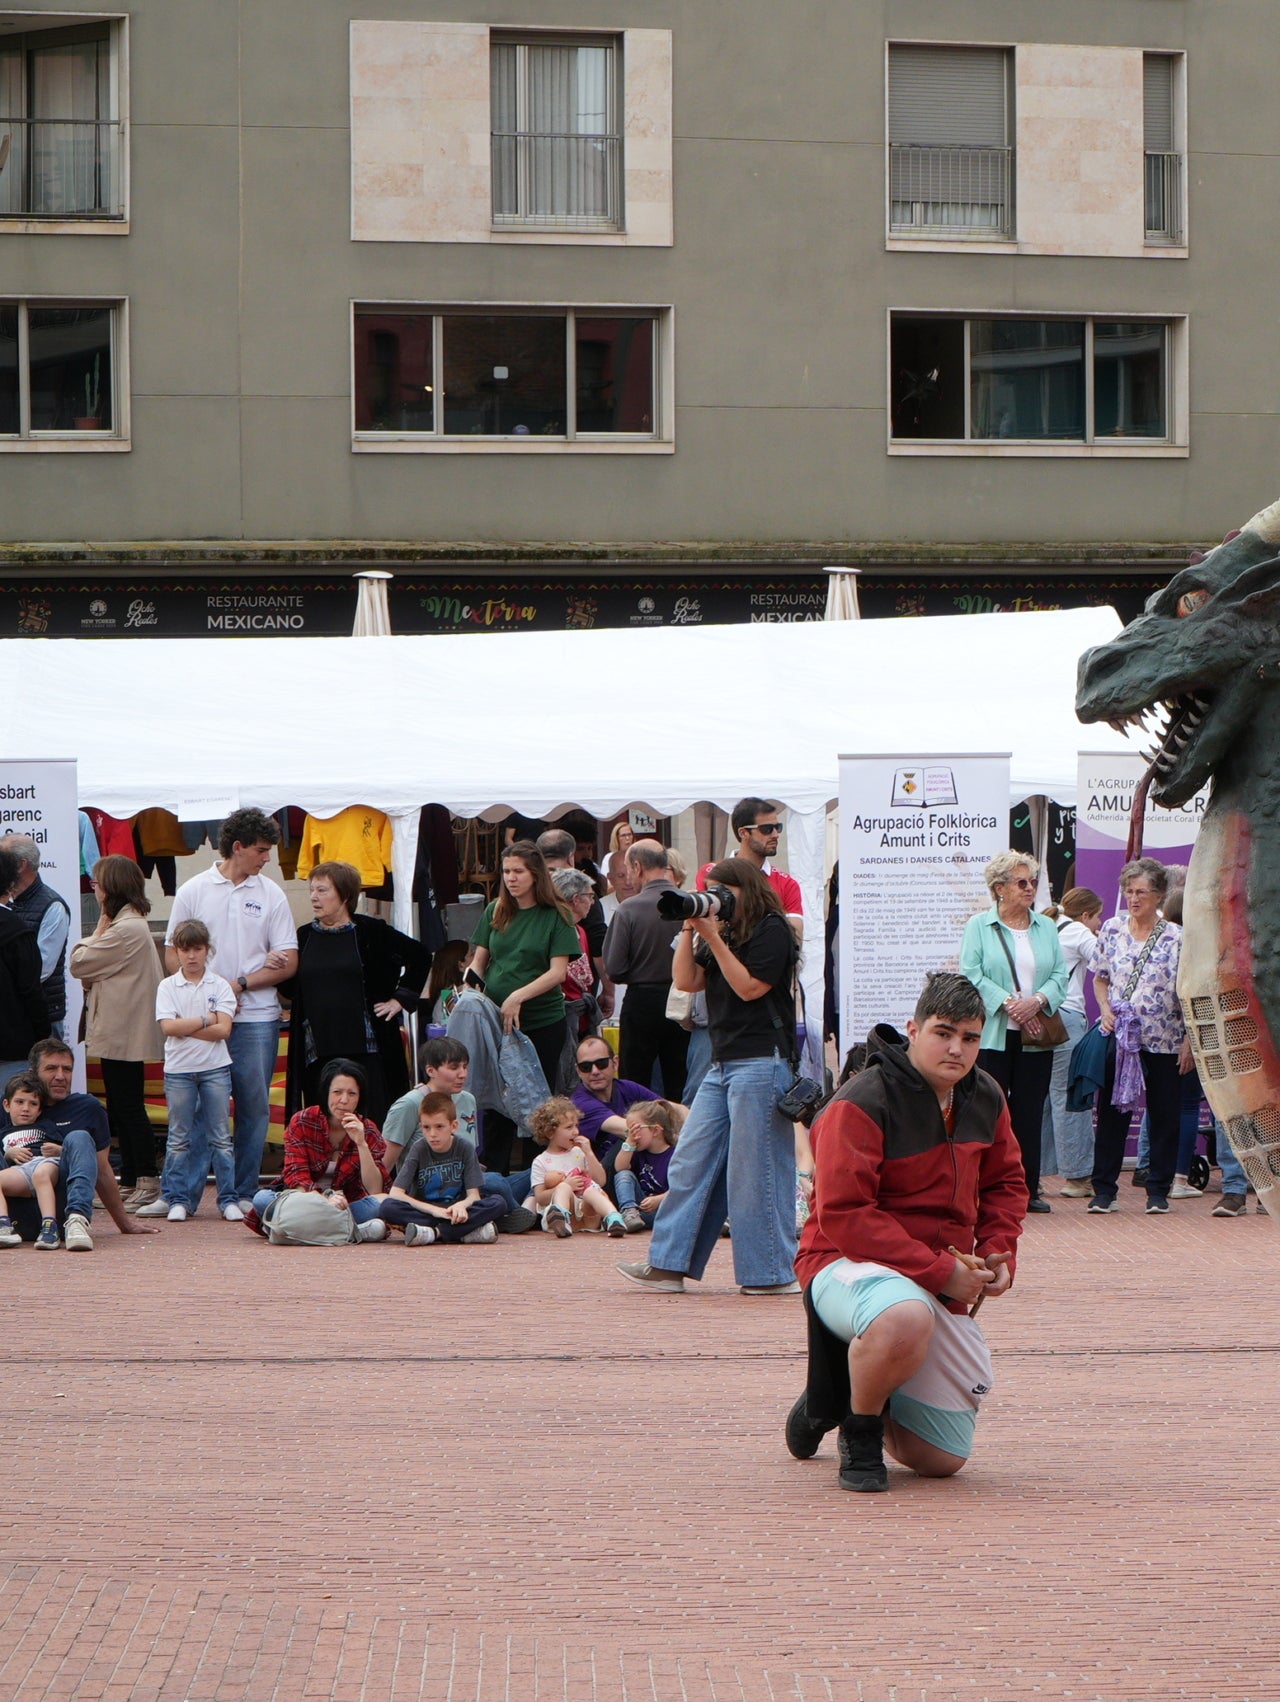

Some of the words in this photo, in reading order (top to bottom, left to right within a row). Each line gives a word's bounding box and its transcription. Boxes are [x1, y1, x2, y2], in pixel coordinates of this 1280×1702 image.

[207, 596, 304, 608] RESTAURANTE
[750, 594, 828, 606] RESTAURAN
[208, 615, 304, 629] MEXICANO
[0, 784, 36, 800] sbart
[853, 812, 925, 833] Agrupació
[929, 813, 997, 829] Folklòrica
[1144, 814, 1172, 822] ocietat
[880, 833, 925, 847] Amunt
[930, 832, 933, 846] i
[937, 832, 971, 847] Crits
[860, 857, 904, 865] SARDANES
[910, 856, 943, 864] DANSES
[945, 855, 992, 864] CATALANES
